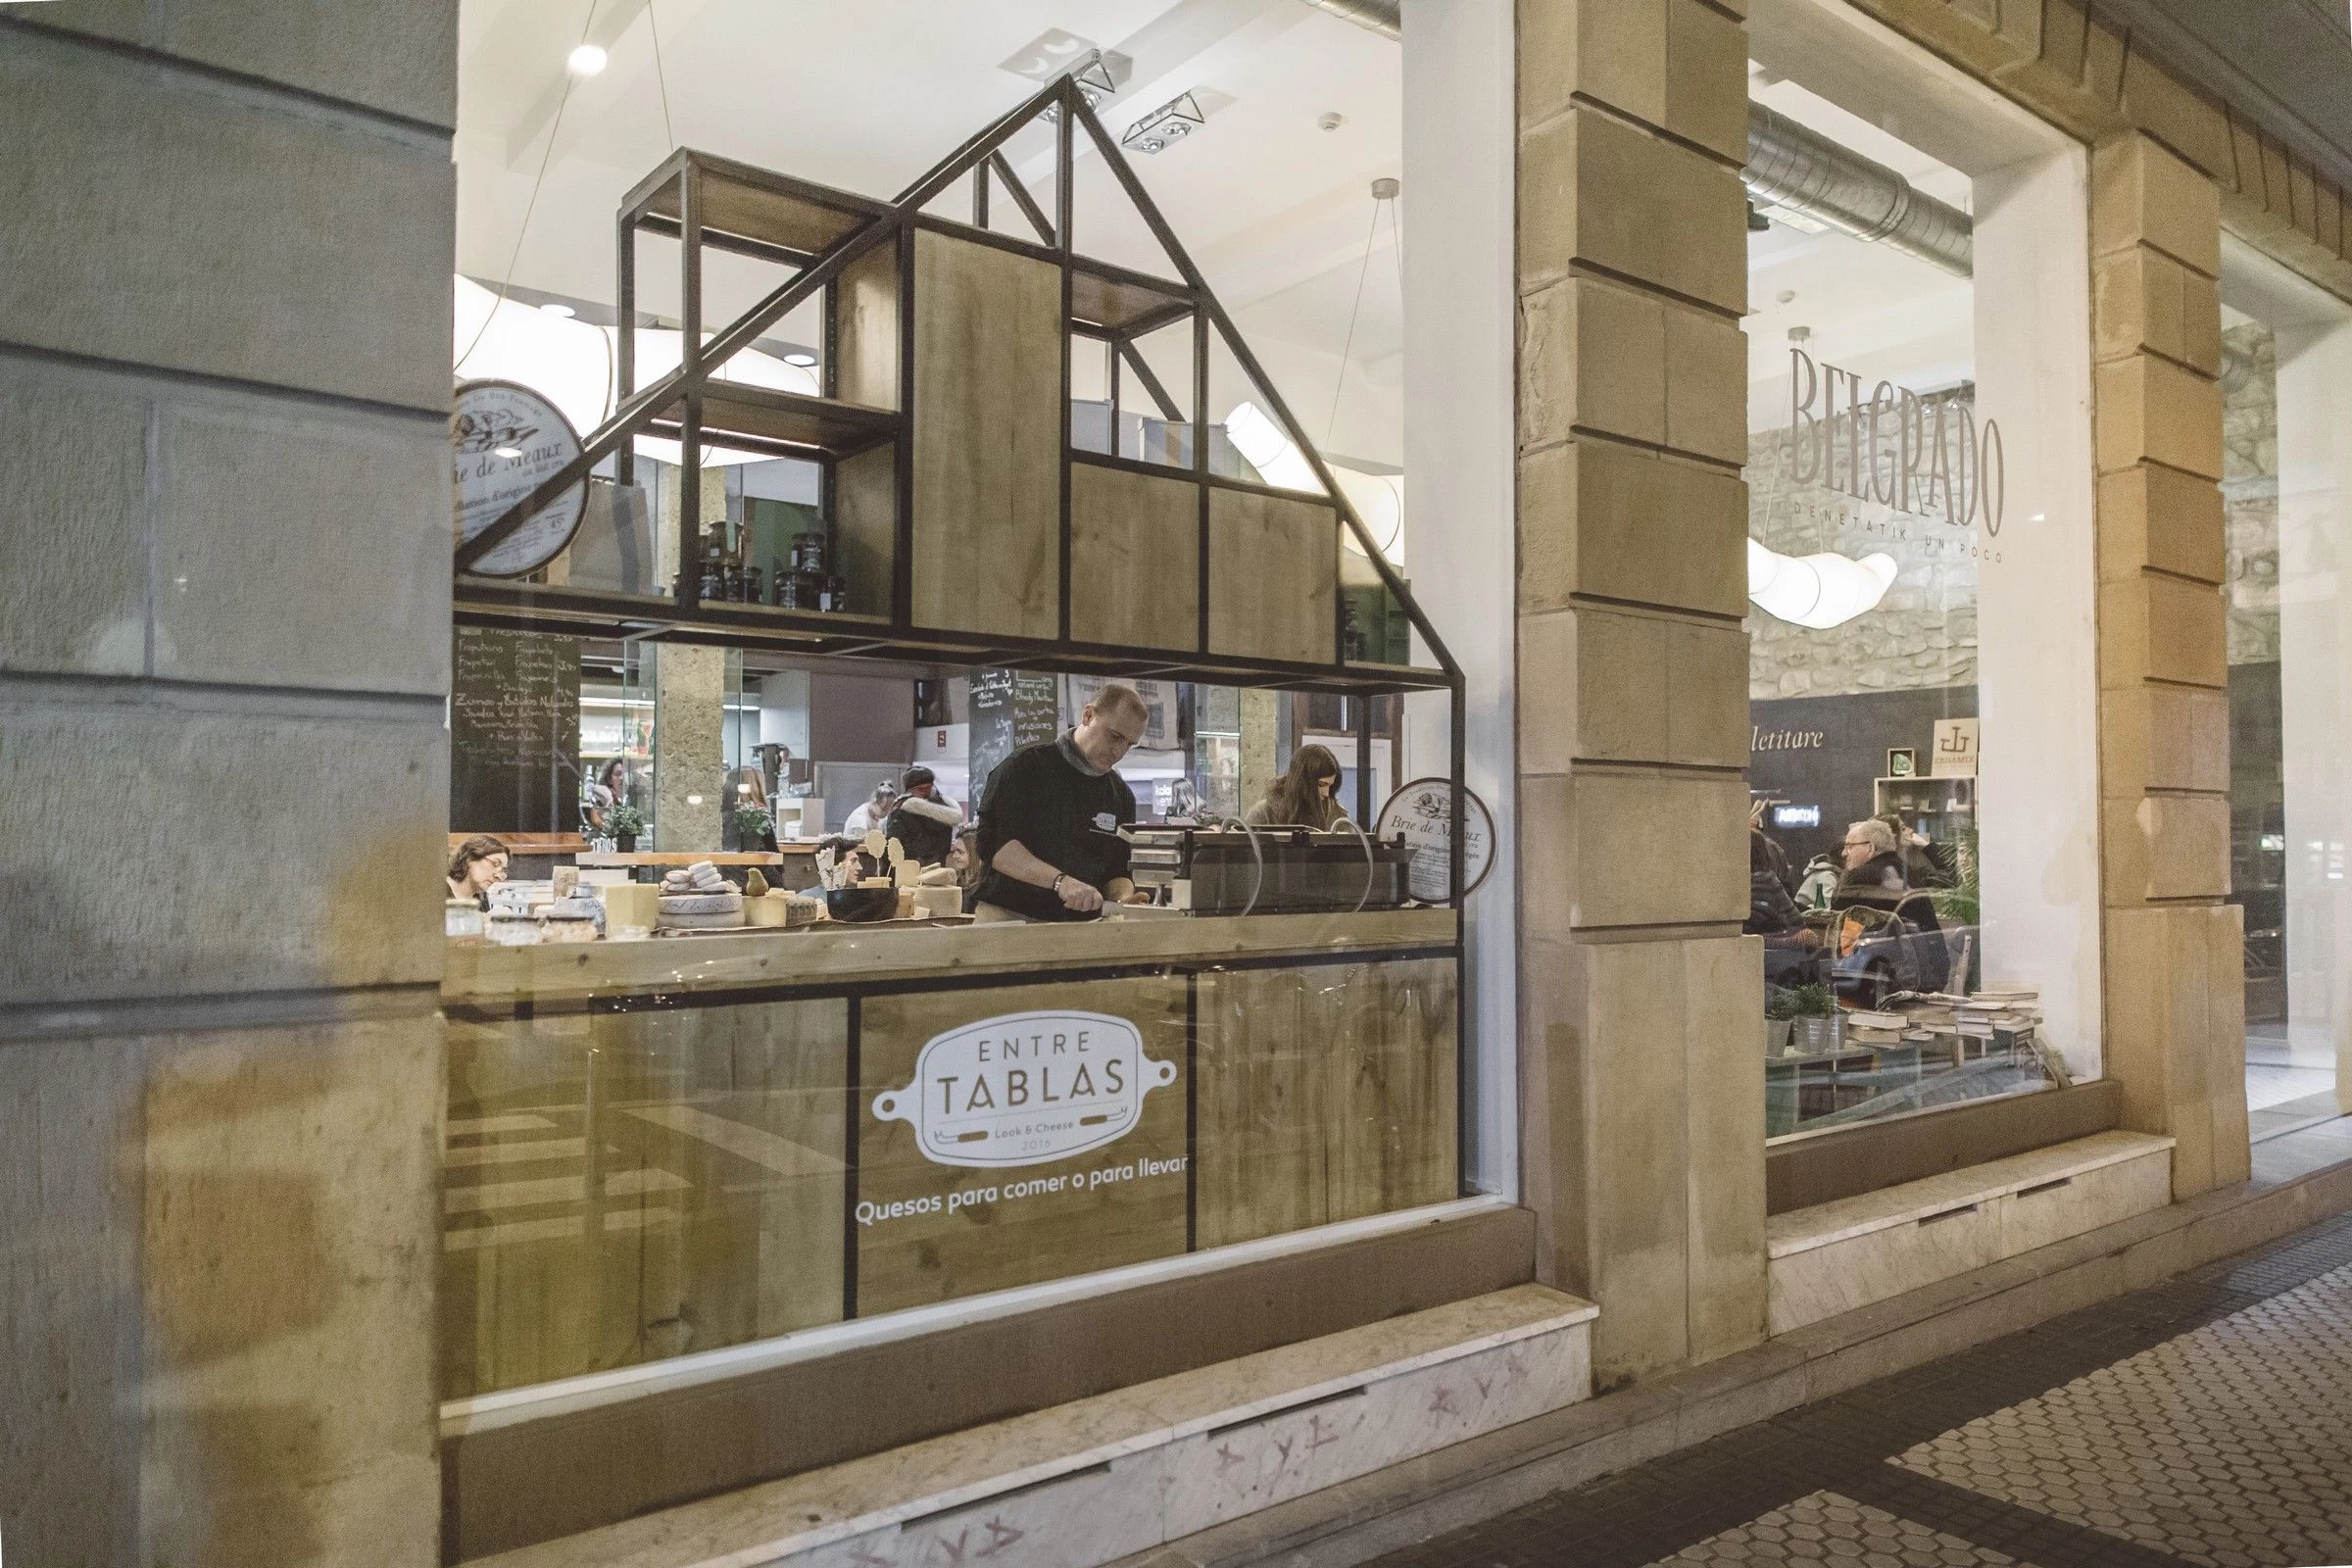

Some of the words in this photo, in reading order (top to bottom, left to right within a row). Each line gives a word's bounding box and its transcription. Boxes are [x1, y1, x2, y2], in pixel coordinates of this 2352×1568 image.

[1789, 348, 2004, 537] BELGRADO
[476, 456, 496, 478] de
[1794, 502, 1906, 541] DENETATIK
[1925, 535, 1945, 550] UN
[1960, 545, 2002, 564] POCO
[1391, 814, 1416, 831] Brie
[1419, 820, 1435, 834] de
[1438, 823, 1482, 843] Mux
[979, 1031, 1090, 1062] ENTRE
[937, 1058, 1125, 1115] TABLAS
[995, 1125, 1021, 1139] Look
[1035, 1121, 1074, 1133] Cheese
[1022, 1140, 1052, 1152] 2016
[855, 1194, 942, 1226] Quesos
[948, 1186, 998, 1213] para
[1003, 1173, 1067, 1200] comer
[1072, 1173, 1085, 1188] o
[1089, 1162, 1134, 1191] para
[1138, 1153, 1189, 1178] llevar
